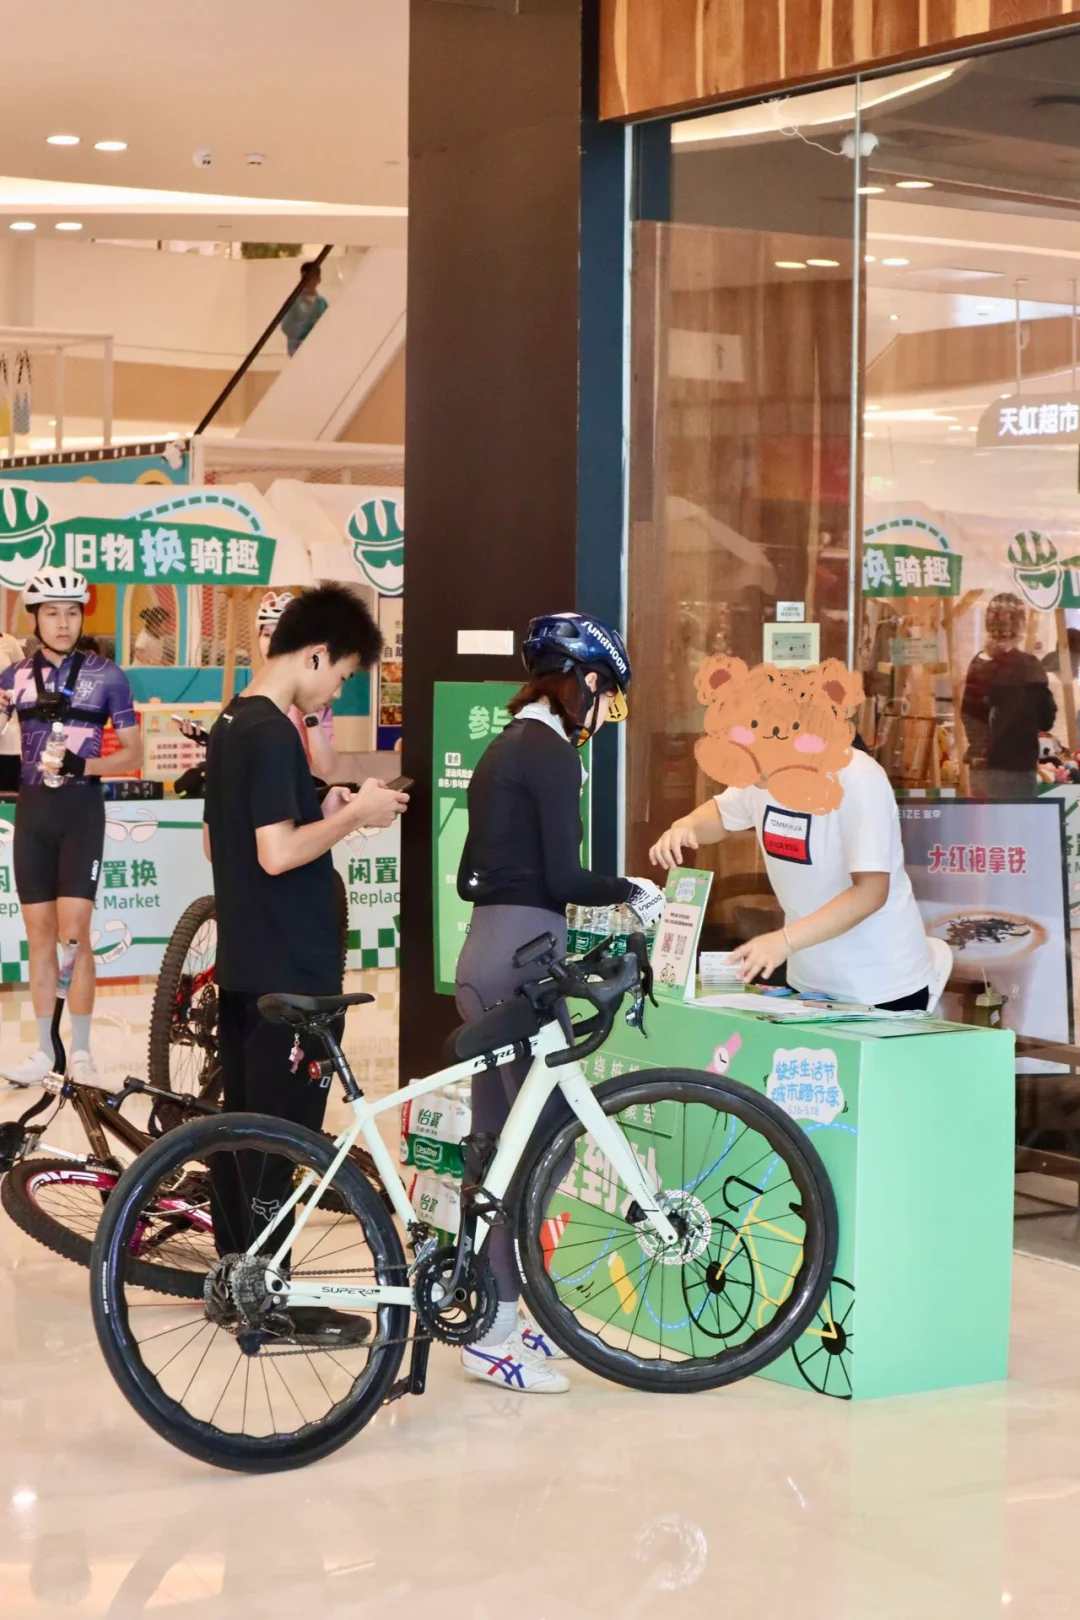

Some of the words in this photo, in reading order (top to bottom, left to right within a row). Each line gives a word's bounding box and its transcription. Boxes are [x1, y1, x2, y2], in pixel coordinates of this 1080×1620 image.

[998, 402, 1080, 436] 天虹超市
[64, 527, 260, 577] 旧物换骑趣
[348, 856, 398, 885] 闲置
[928, 844, 1027, 875] 大红袍拿铁
[103, 893, 160, 910] Market
[775, 1058, 836, 1082] 快乐生活节
